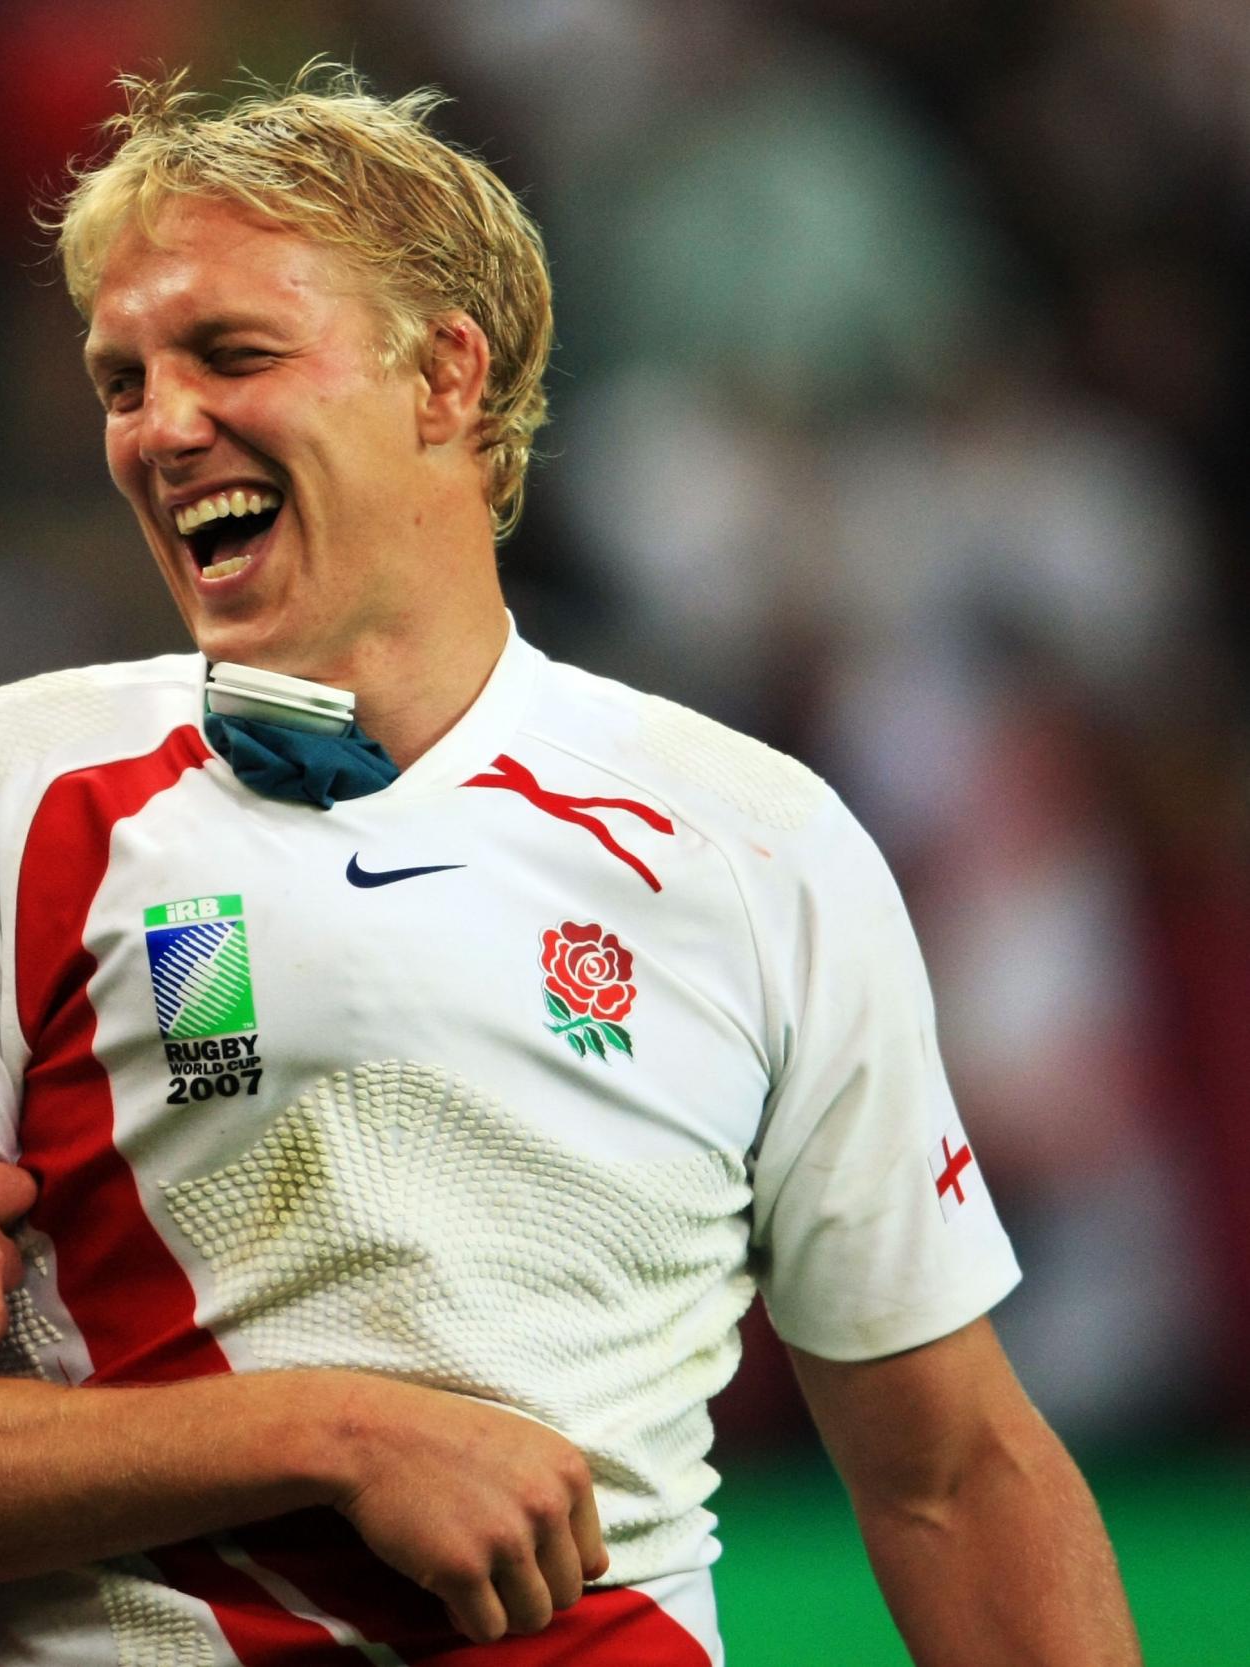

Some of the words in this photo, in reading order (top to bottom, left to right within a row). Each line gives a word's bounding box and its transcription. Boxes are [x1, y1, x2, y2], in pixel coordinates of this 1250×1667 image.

[164, 1034, 258, 1062] RUGBY
[169, 1062, 224, 1075] WORLD
[227, 1056, 261, 1070] CUP
[166, 1069, 263, 1104] 2007
